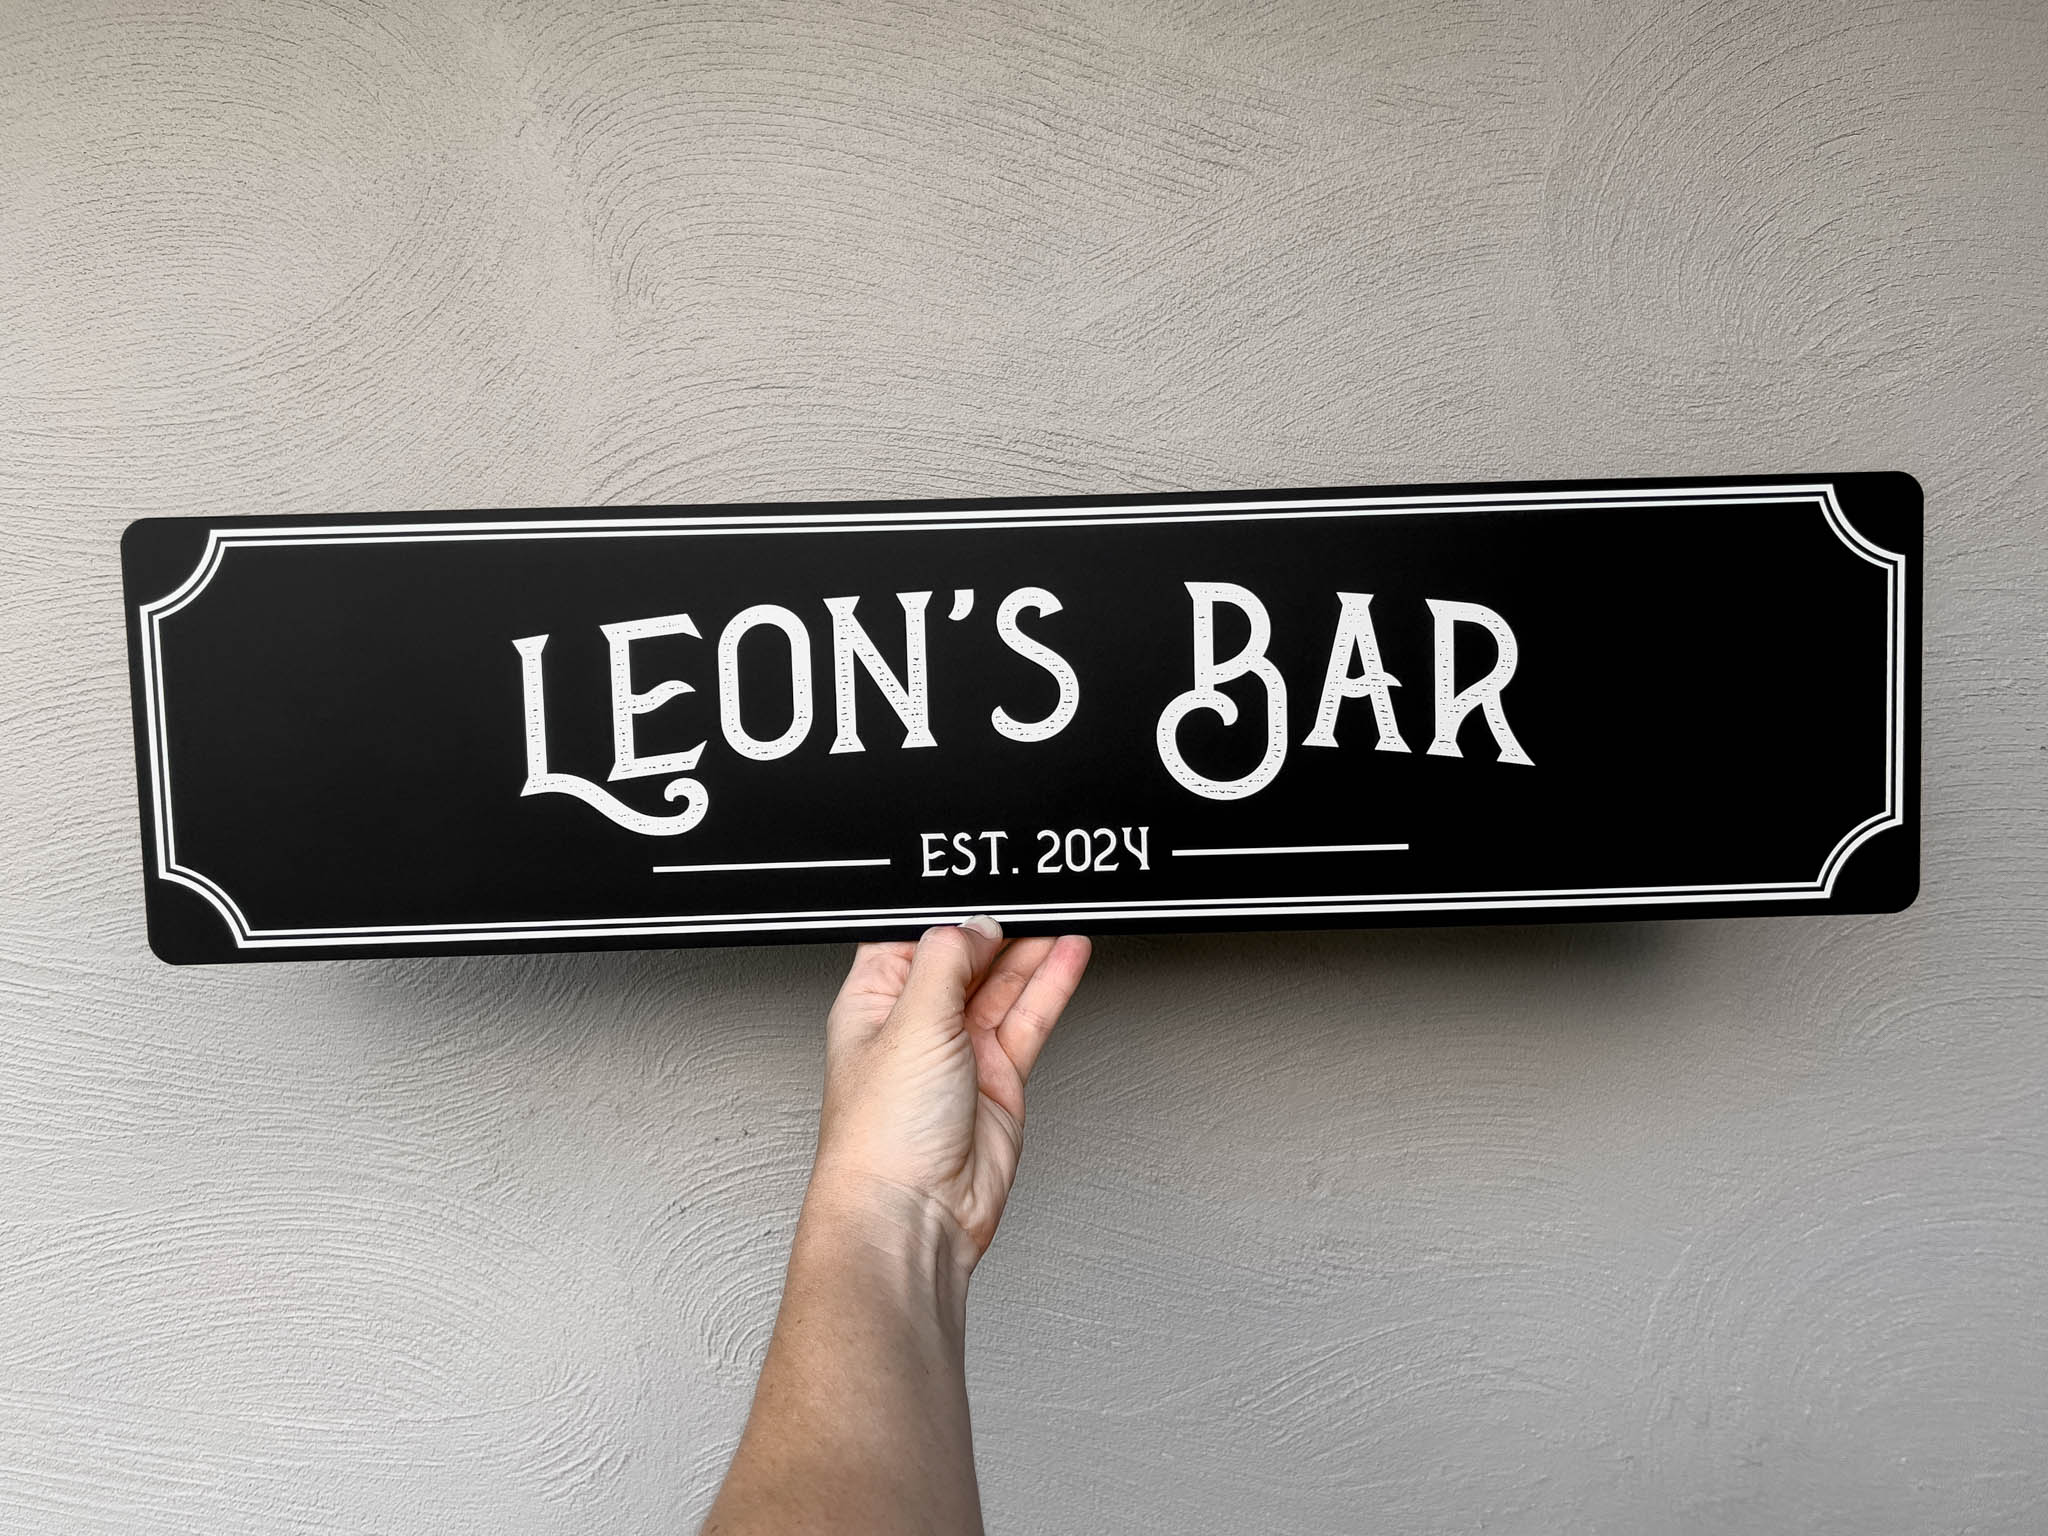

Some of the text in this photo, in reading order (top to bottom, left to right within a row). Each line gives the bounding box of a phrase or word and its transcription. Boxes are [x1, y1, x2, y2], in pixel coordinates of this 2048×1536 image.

[511, 581, 1536, 837] LEON'S BAR
[919, 826, 1151, 878] EST. 2024
